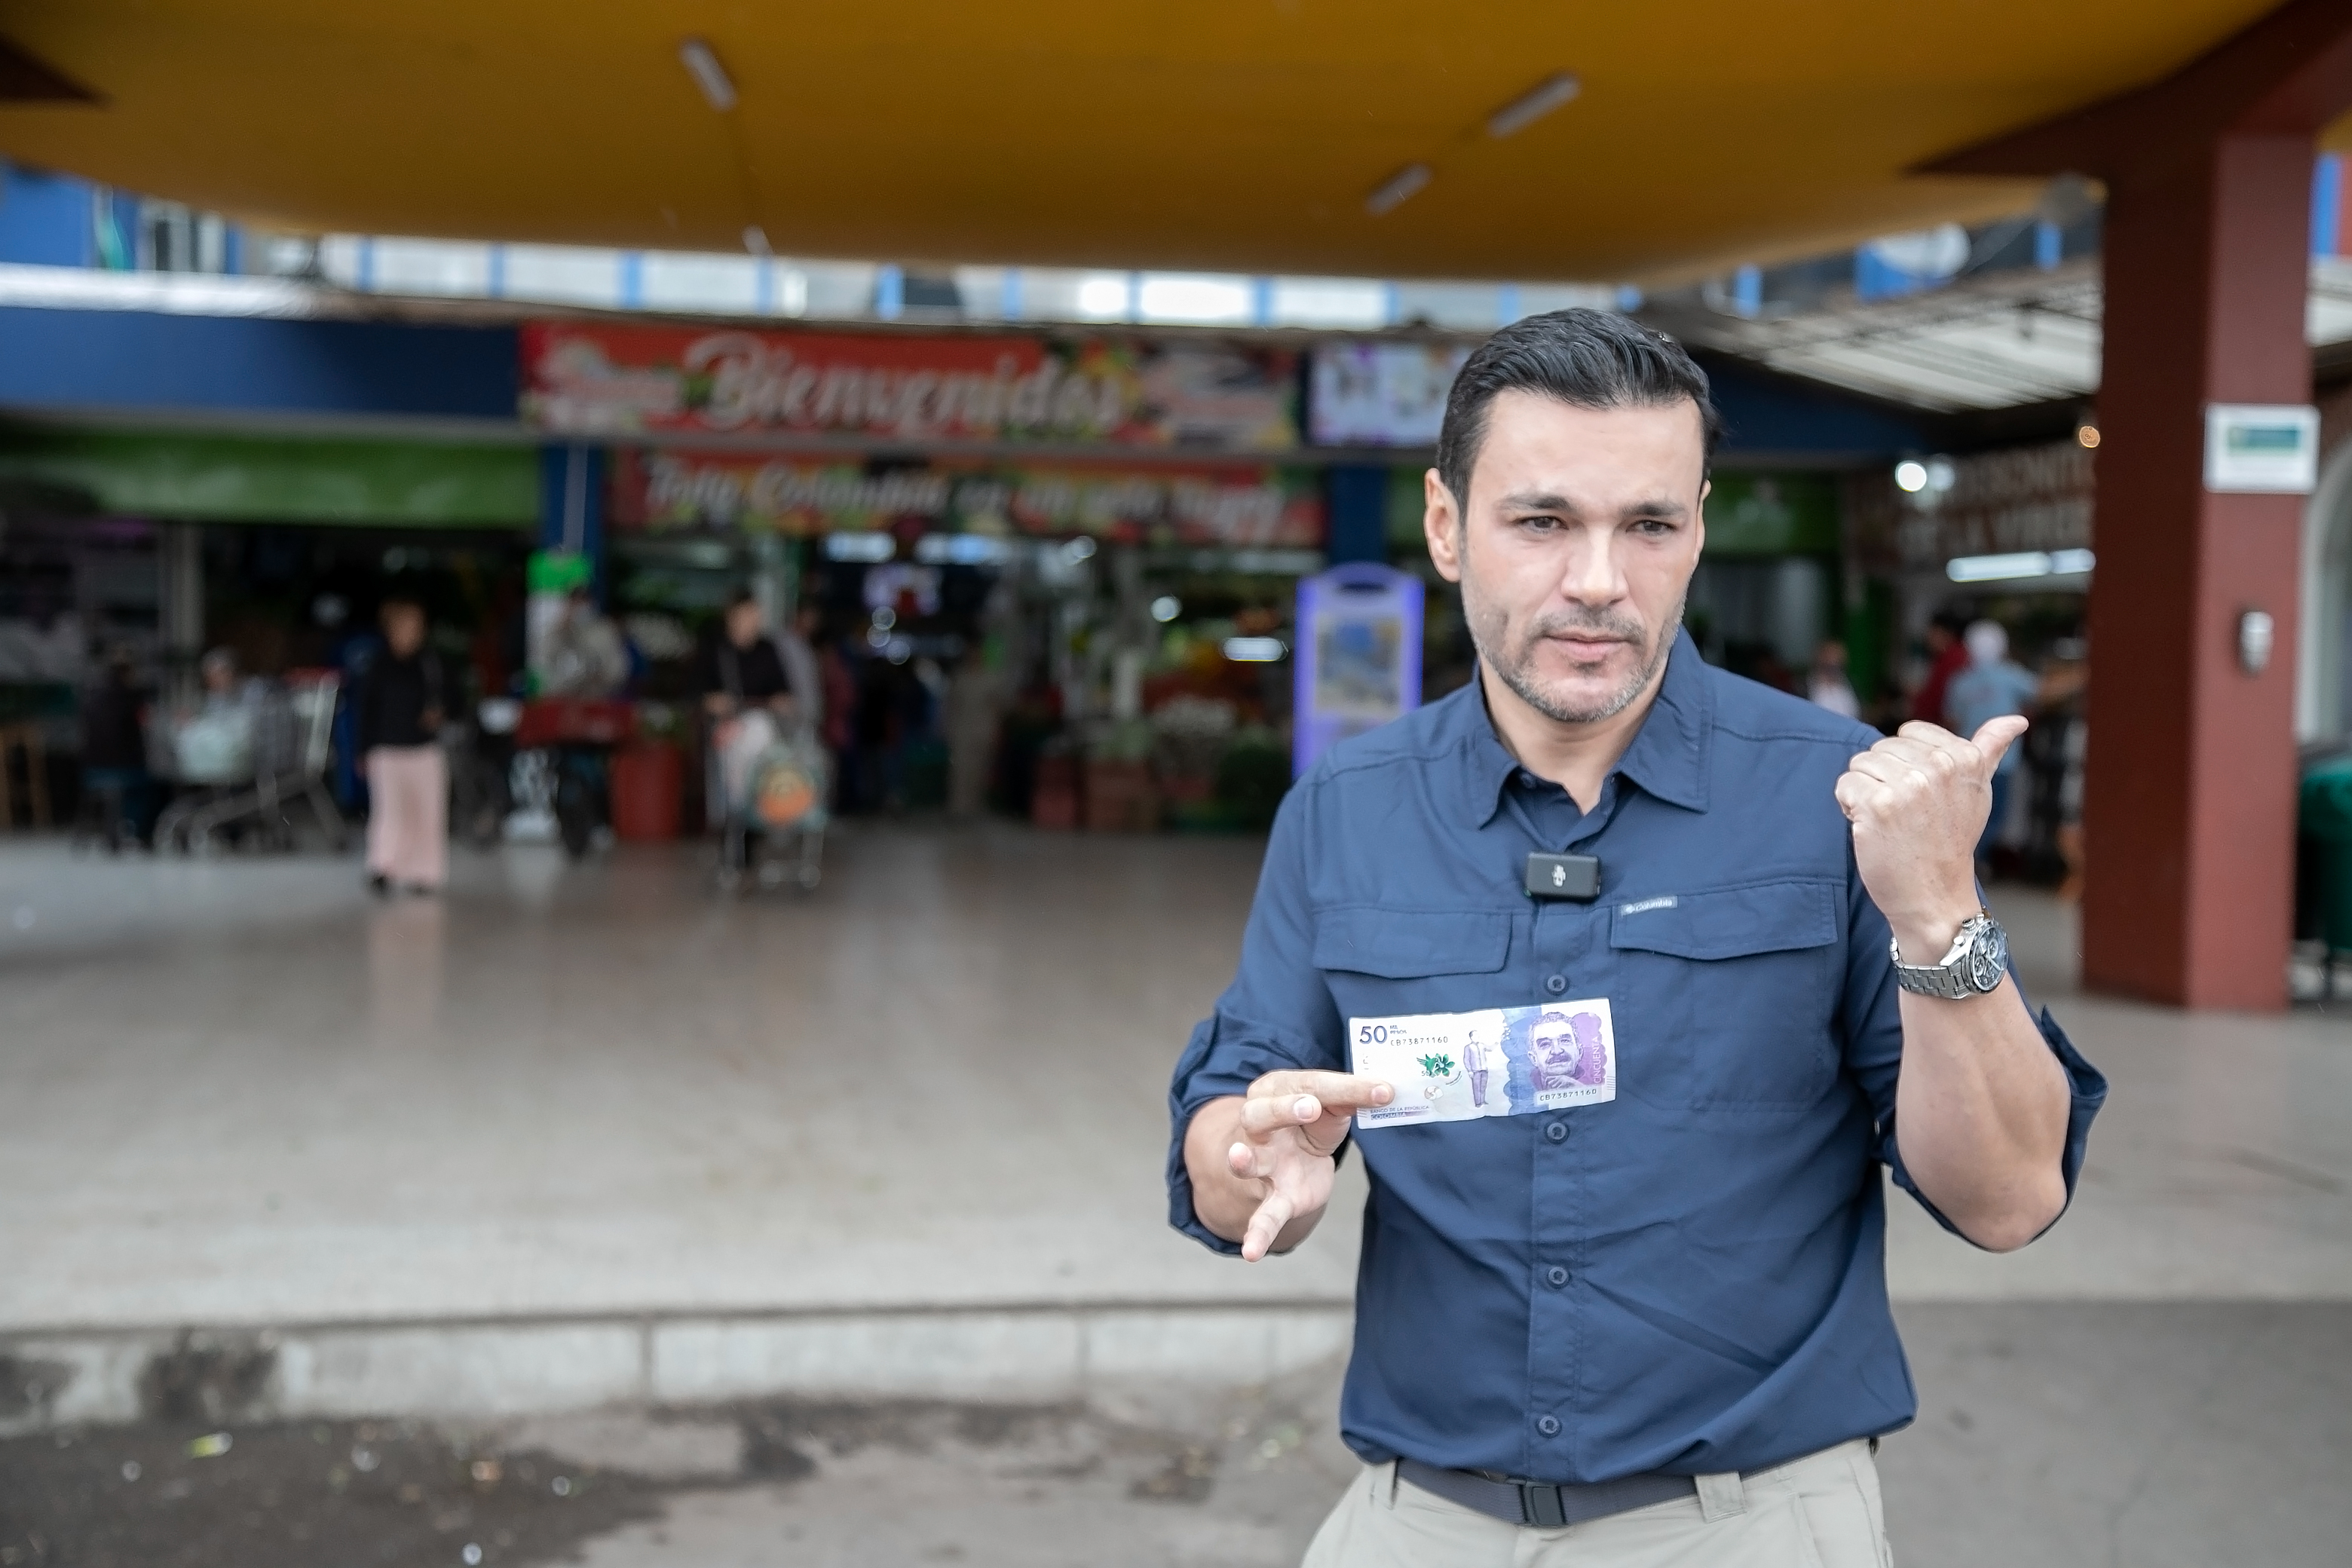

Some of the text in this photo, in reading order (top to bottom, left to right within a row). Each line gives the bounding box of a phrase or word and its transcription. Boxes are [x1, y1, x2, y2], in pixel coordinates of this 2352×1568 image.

[682, 330, 1123, 441] Bienvenidos
[1359, 1025, 1388, 1044] 50
[1390, 1037, 1448, 1046] CB73871160
[1592, 1036, 1602, 1083] CINCUENTA
[1539, 1089, 1597, 1101] CB73871160
